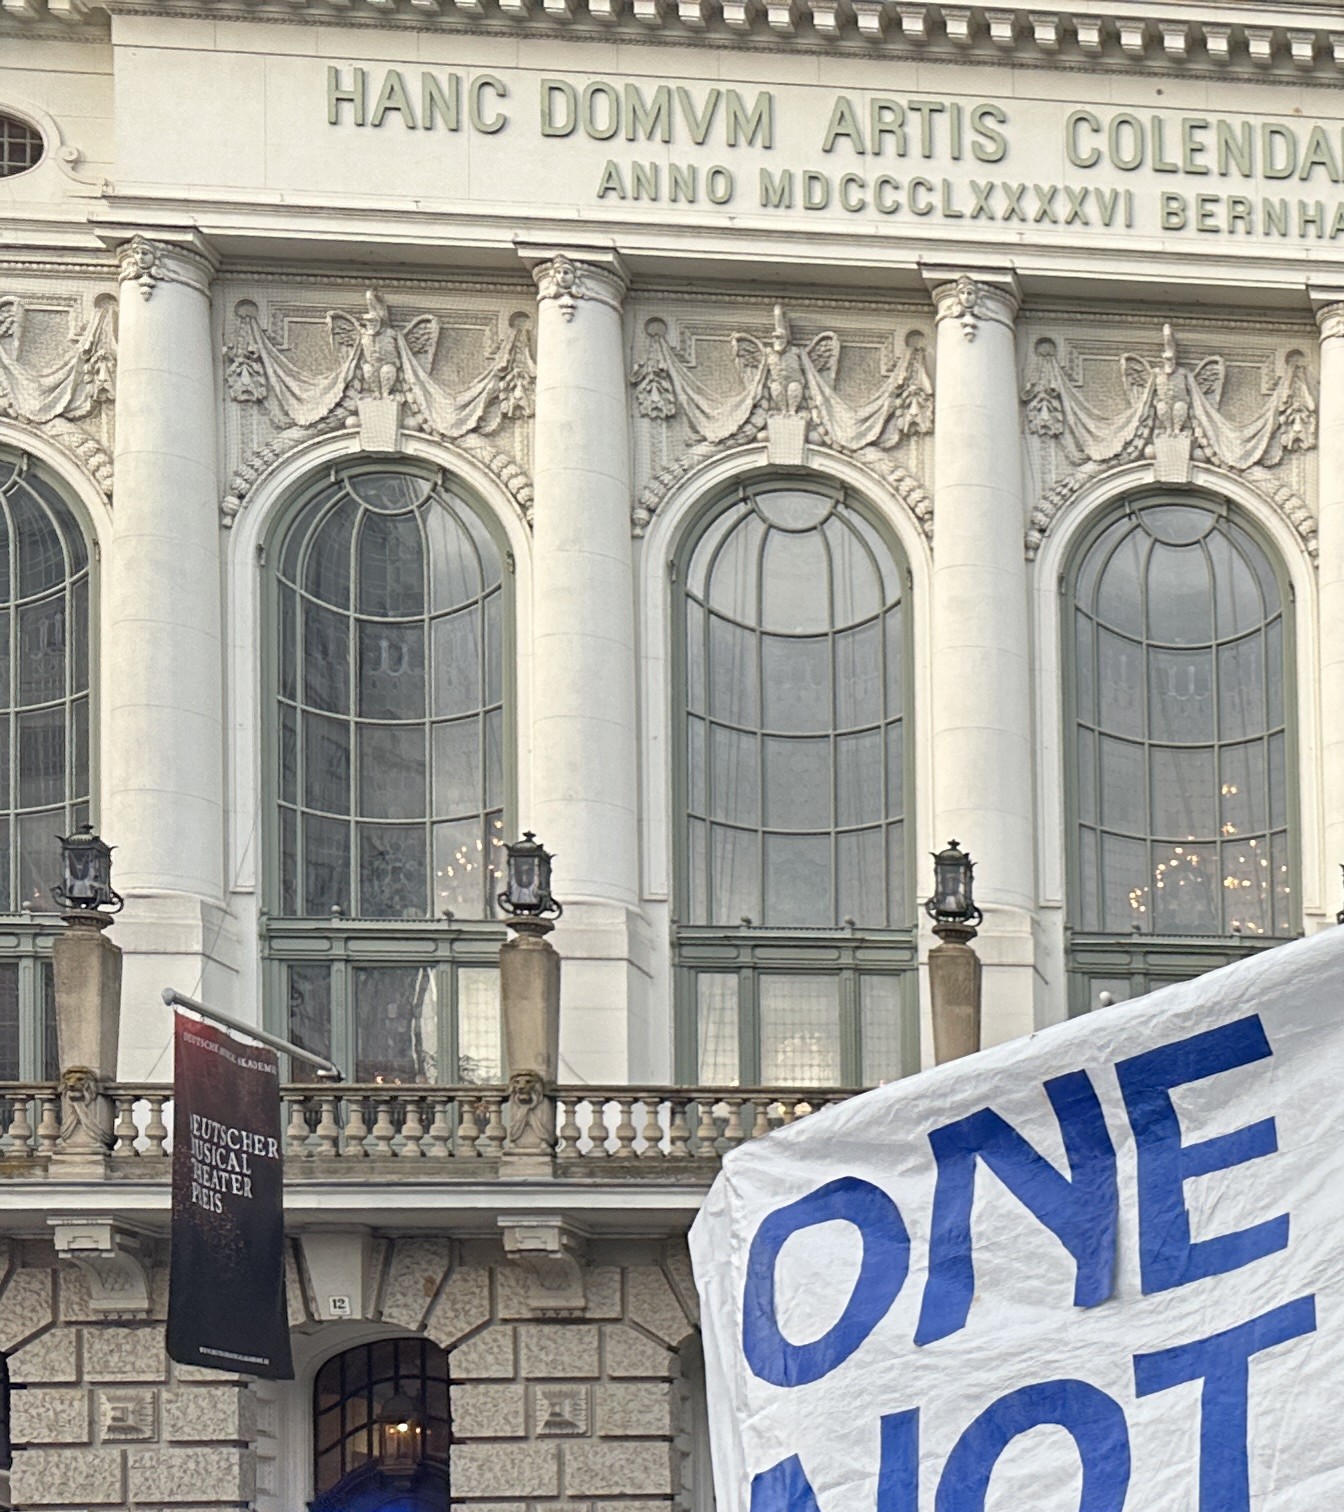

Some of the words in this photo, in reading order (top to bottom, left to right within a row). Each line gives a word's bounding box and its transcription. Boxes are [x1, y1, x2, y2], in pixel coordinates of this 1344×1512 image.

[326, 66, 508, 135] HANC
[540, 78, 774, 150] DOMVM
[822, 95, 1008, 163] ARTIS
[597, 160, 735, 205] ANNO
[759, 167, 1133, 229] MDCCCLXXXXVI
[742, 1020, 1290, 1388] ONE
[332, 1298, 346, 1310] 12
